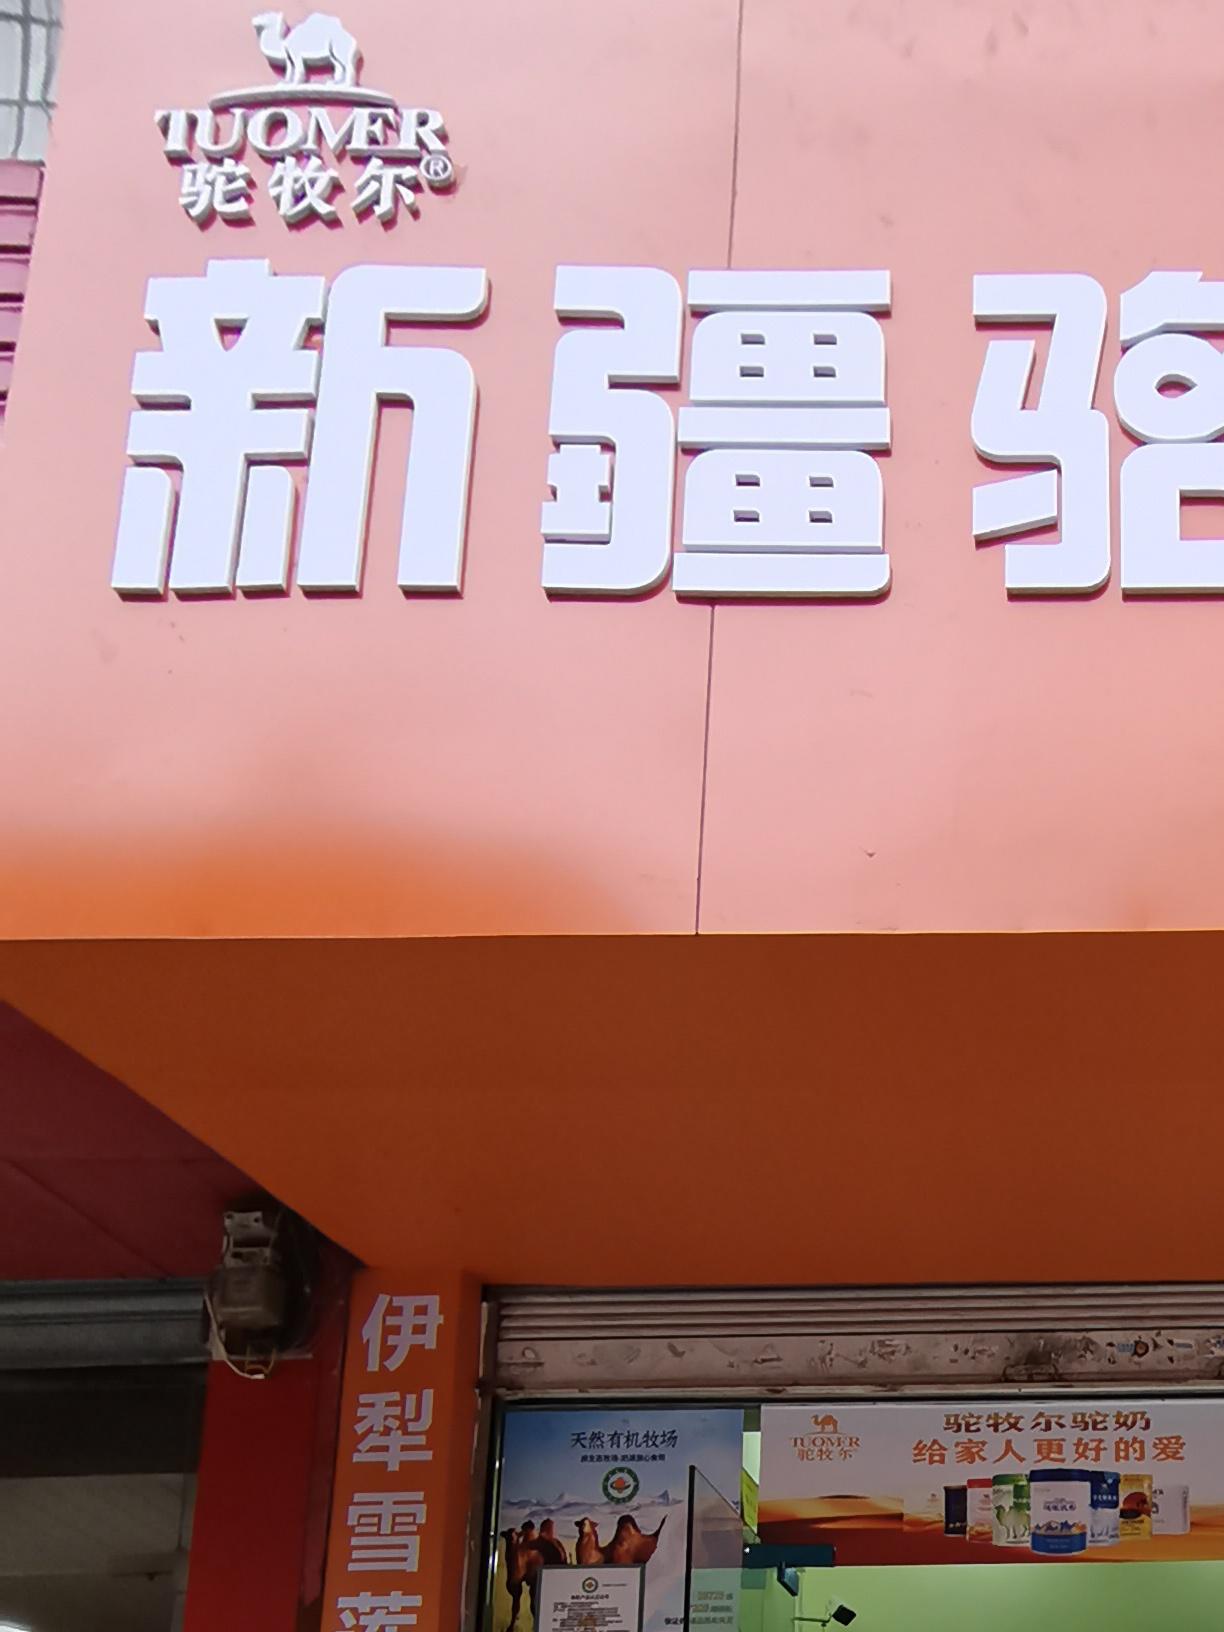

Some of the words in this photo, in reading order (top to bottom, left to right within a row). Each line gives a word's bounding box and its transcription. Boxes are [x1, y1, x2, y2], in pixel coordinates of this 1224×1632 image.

[154, 107, 449, 155] TUOMER
[943, 1410, 1152, 1434] 驼牧尔驼奶
[571, 1429, 679, 1449] 天然有机牧场
[911, 1435, 1187, 1466] 给家人更好的爱
